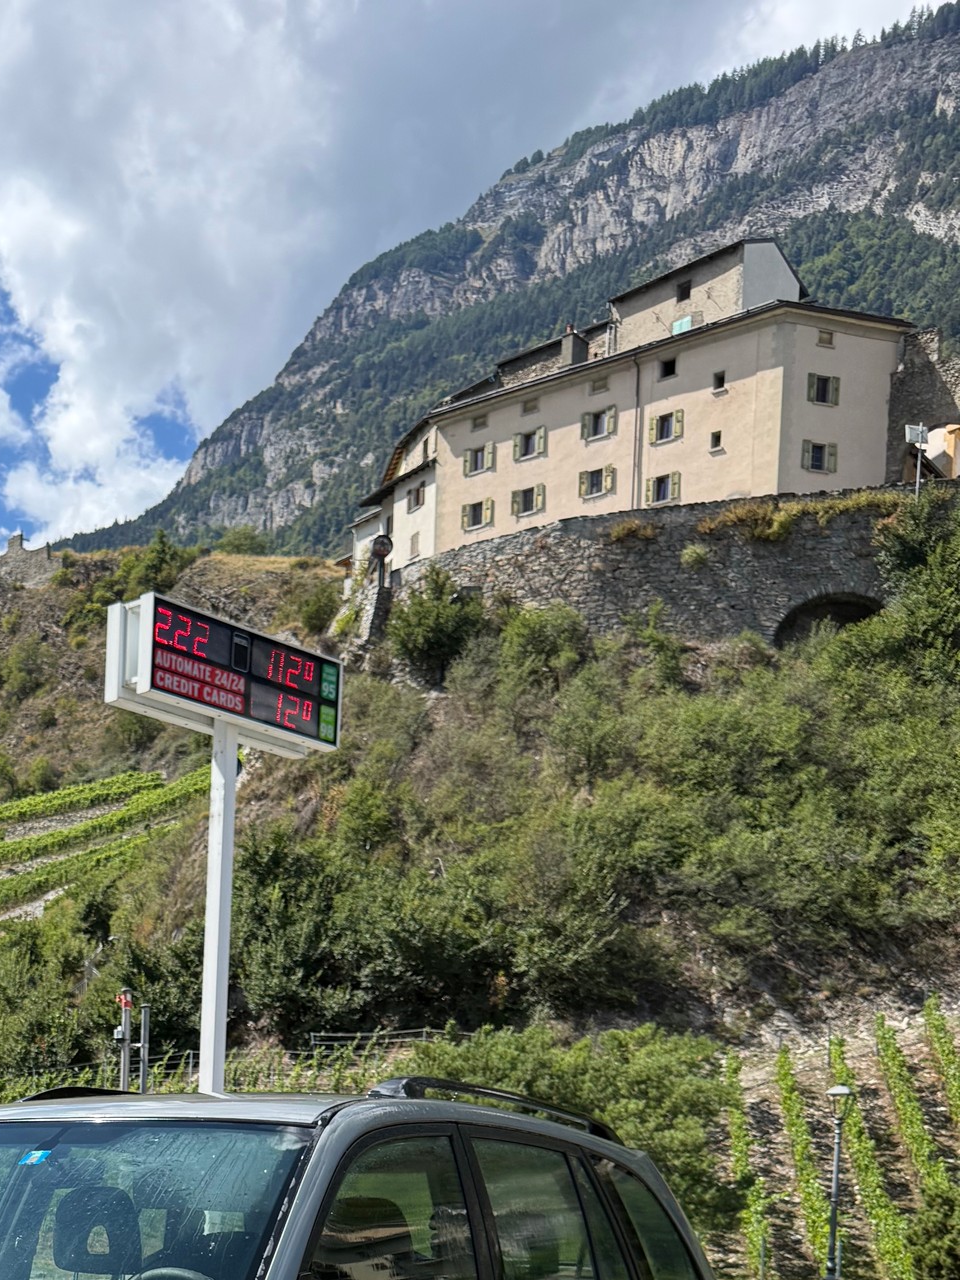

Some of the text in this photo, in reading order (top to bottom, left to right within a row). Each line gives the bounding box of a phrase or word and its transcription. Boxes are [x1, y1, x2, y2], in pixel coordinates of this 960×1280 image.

[155, 650, 245, 693] AUTOMATE 24/24
[156, 671, 242, 711] CREDIT CARDS
[322, 682, 336, 699] 95
[320, 722, 334, 739] 98
